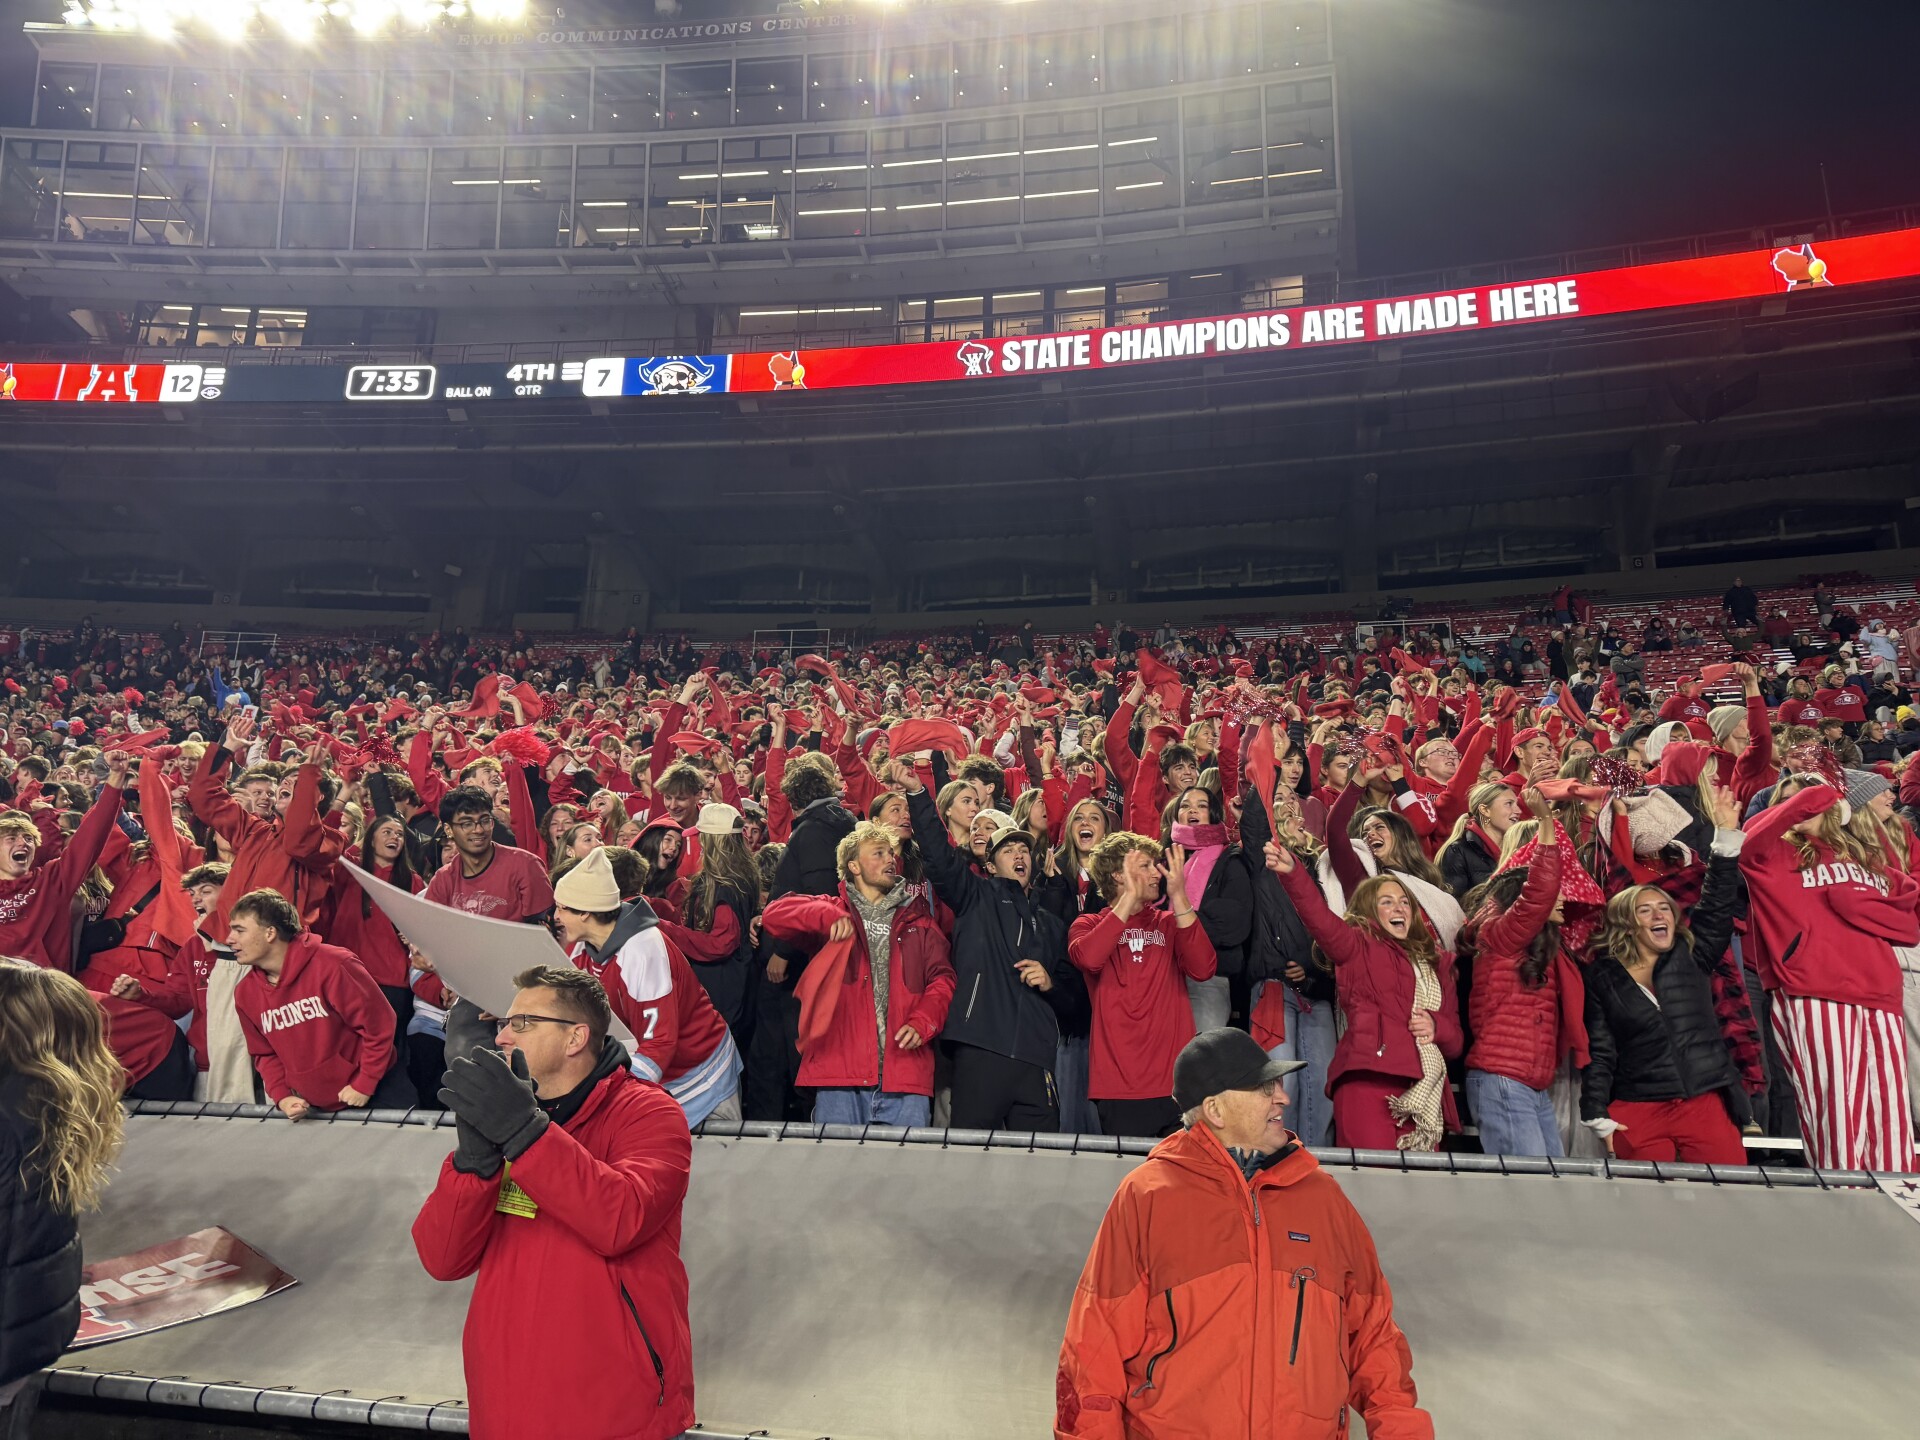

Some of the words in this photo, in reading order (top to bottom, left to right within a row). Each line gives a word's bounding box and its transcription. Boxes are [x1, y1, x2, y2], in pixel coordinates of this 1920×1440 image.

[456, 32, 525, 46] EVJUE
[535, 21, 752, 43] COMMUNICATIONS
[762, 15, 858, 32] CENTER
[1001, 332, 1090, 372] STATE
[1101, 312, 1290, 364] CHAMPIONS
[1301, 304, 1365, 344] ARE
[1376, 293, 1478, 336] MADE
[1490, 279, 1579, 322] HERE
[359, 371, 420, 392] 7:35
[506, 364, 555, 382] 4TH
[597, 369, 611, 388] 7
[171, 375, 194, 393] 12
[445, 387, 472, 398] BALL
[474, 387, 492, 397] ON
[514, 384, 542, 396] QTR
[1128, 938, 1145, 953] W
[642, 1007, 659, 1040] 7
